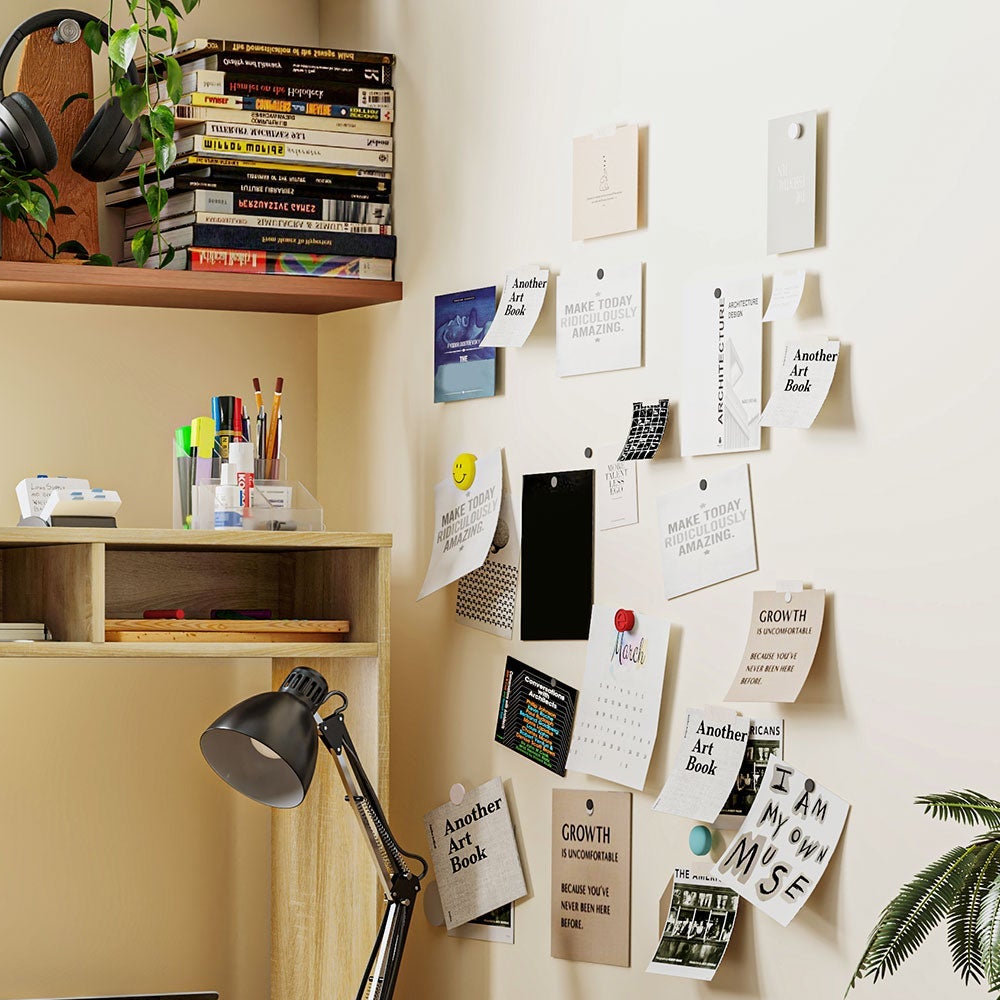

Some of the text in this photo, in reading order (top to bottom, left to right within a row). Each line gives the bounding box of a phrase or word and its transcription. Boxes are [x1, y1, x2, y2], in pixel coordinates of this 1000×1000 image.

[512, 277, 547, 290] Another
[509, 292, 524, 303] Art
[565, 295, 633, 315] MAKE TODAY
[728, 297, 759, 309] ARCHITECTURE
[504, 304, 527, 317] Book
[560, 305, 637, 329] RIDICULOUSLY
[728, 311, 743, 319] DESIGN
[572, 321, 624, 339] AMAZING.
[717, 297, 725, 425] ARCHITECTURE
[793, 349, 838, 362] Another
[789, 364, 808, 377] Art
[784, 379, 812, 393] Book
[441, 487, 496, 528] MAKE TODAY
[668, 498, 741, 535] MAKE TODAY
[437, 499, 498, 544] RIDICULOUSLY
[665, 508, 748, 549] RIDICULOUSLY
[443, 522, 485, 554] AMAZING.
[678, 528, 736, 557] AMAZING.
[759, 609, 807, 623] GROWTH
[763, 627, 813, 635] UNCOMFORTABLE
[611, 632, 646, 666] March
[750, 652, 798, 660] BECAUSE YOU'VE
[524, 676, 565, 701] Conversations
[537, 689, 550, 700] with
[528, 690, 558, 710] Architects
[696, 720, 748, 743] Another
[750, 725, 781, 736] RICANS
[692, 738, 714, 756] Art
[685, 756, 718, 776] Book
[771, 767, 828, 822] I AM
[444, 797, 502, 837] Another
[561, 823, 611, 844] GROWTH
[760, 803, 829, 863] MY OWN
[448, 832, 473, 856] Art
[450, 845, 488, 874] Book
[561, 848, 619, 863] IS UNCOMFORTABLE
[675, 868, 690, 879] THE
[724, 837, 810, 900] MUSE
[561, 883, 586, 895] BECAUSE
[561, 900, 611, 915] NEVER BEEN HERE
[561, 917, 584, 930] BEFORE.
